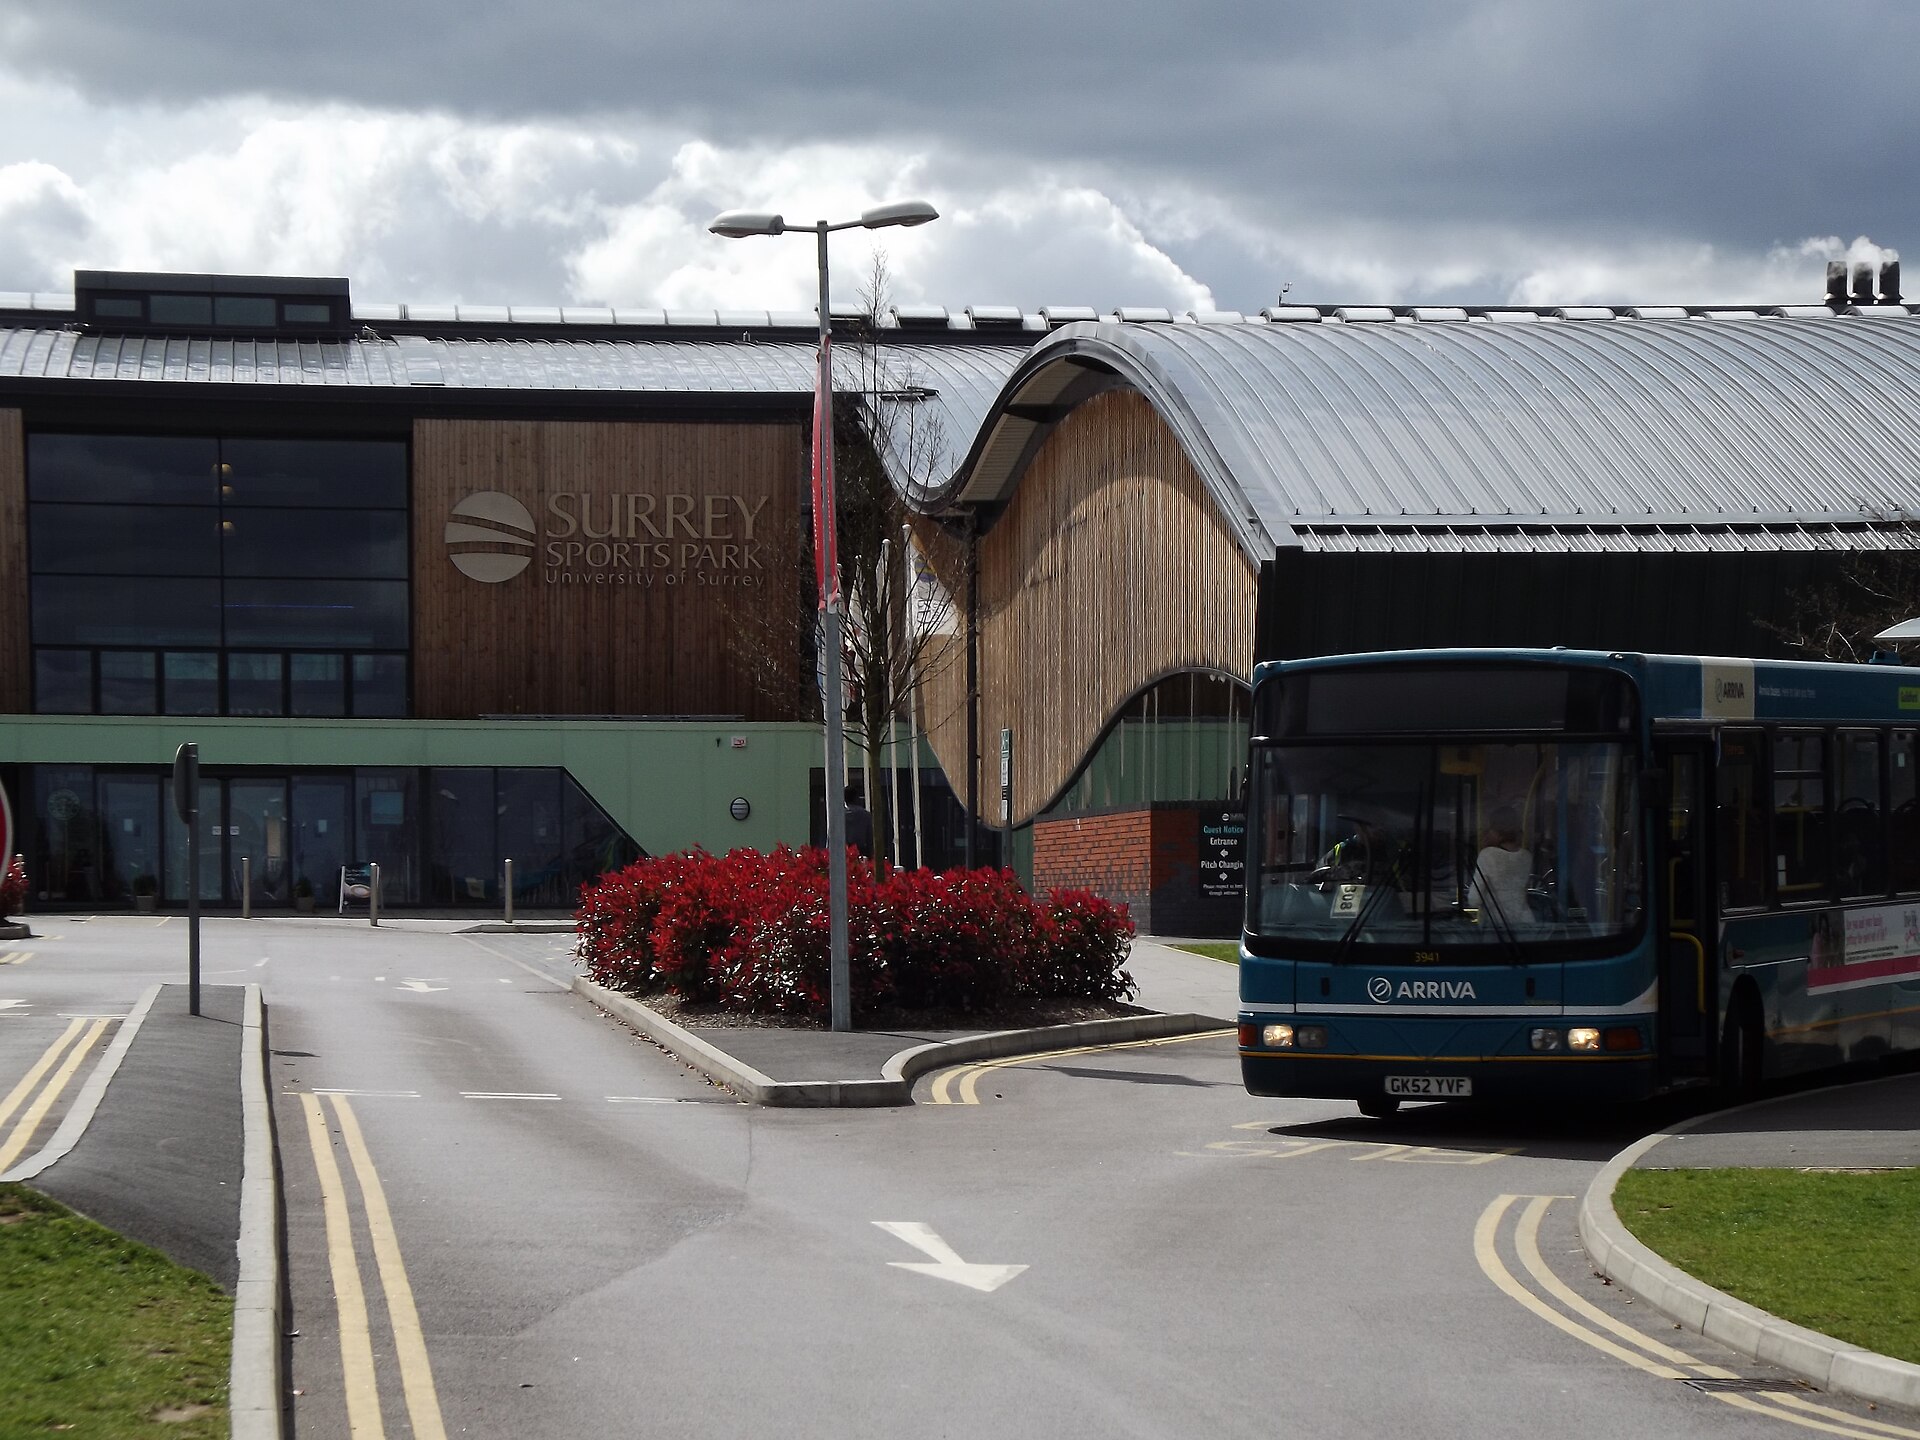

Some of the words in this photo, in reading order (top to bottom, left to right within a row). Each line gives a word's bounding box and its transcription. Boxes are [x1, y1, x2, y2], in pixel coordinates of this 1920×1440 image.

[546, 492, 769, 539] SURREY
[546, 542, 671, 569] SPORTS
[681, 542, 763, 569] PARK
[546, 570, 655, 588] University
[665, 570, 687, 585] of
[696, 571, 765, 588] Surrey
[1723, 682, 1745, 699] ARRIVA
[1209, 837, 1238, 846] Entrance
[1200, 860, 1218, 869] Pitch
[1415, 951, 1440, 963] 3941
[1396, 981, 1477, 999] ARRIVA
[1391, 1078, 1431, 1093] GK52
[1435, 1078, 1465, 1093] YVF
